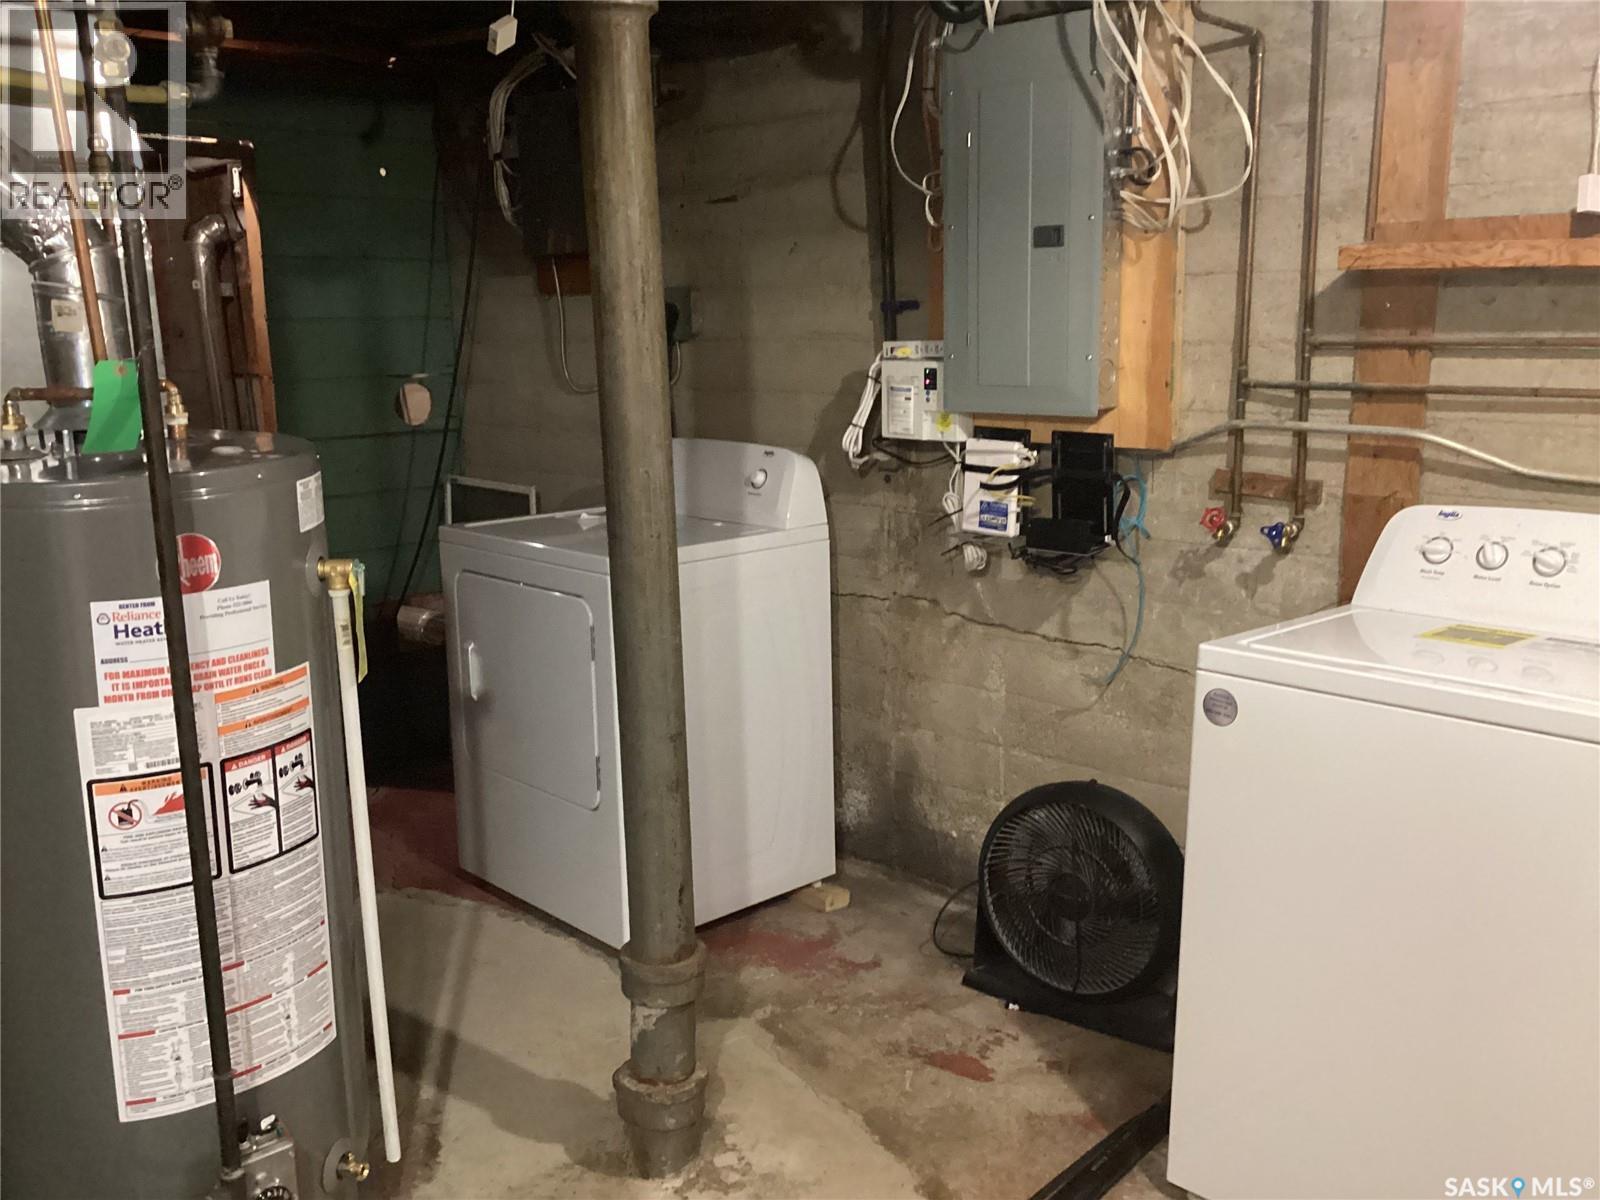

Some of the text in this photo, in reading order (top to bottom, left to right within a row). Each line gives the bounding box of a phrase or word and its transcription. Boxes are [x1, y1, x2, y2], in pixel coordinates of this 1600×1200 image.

[112, 610, 161, 622] Reliance
[104, 671, 121, 681] FOR
[122, 667, 165, 679] MAXIMUM
[211, 657, 226, 667] AND
[227, 647, 269, 664] CLEANLINESS
[111, 683, 119, 692] IT
[122, 682, 130, 691] IS
[132, 678, 171, 690] IMPORTA
[217, 665, 242, 677] WATER
[243, 661, 260, 670] ONCE
[104, 693, 134, 704] MONTH
[136, 690, 160, 700] FROM
[204, 680, 225, 691] UNTIL
